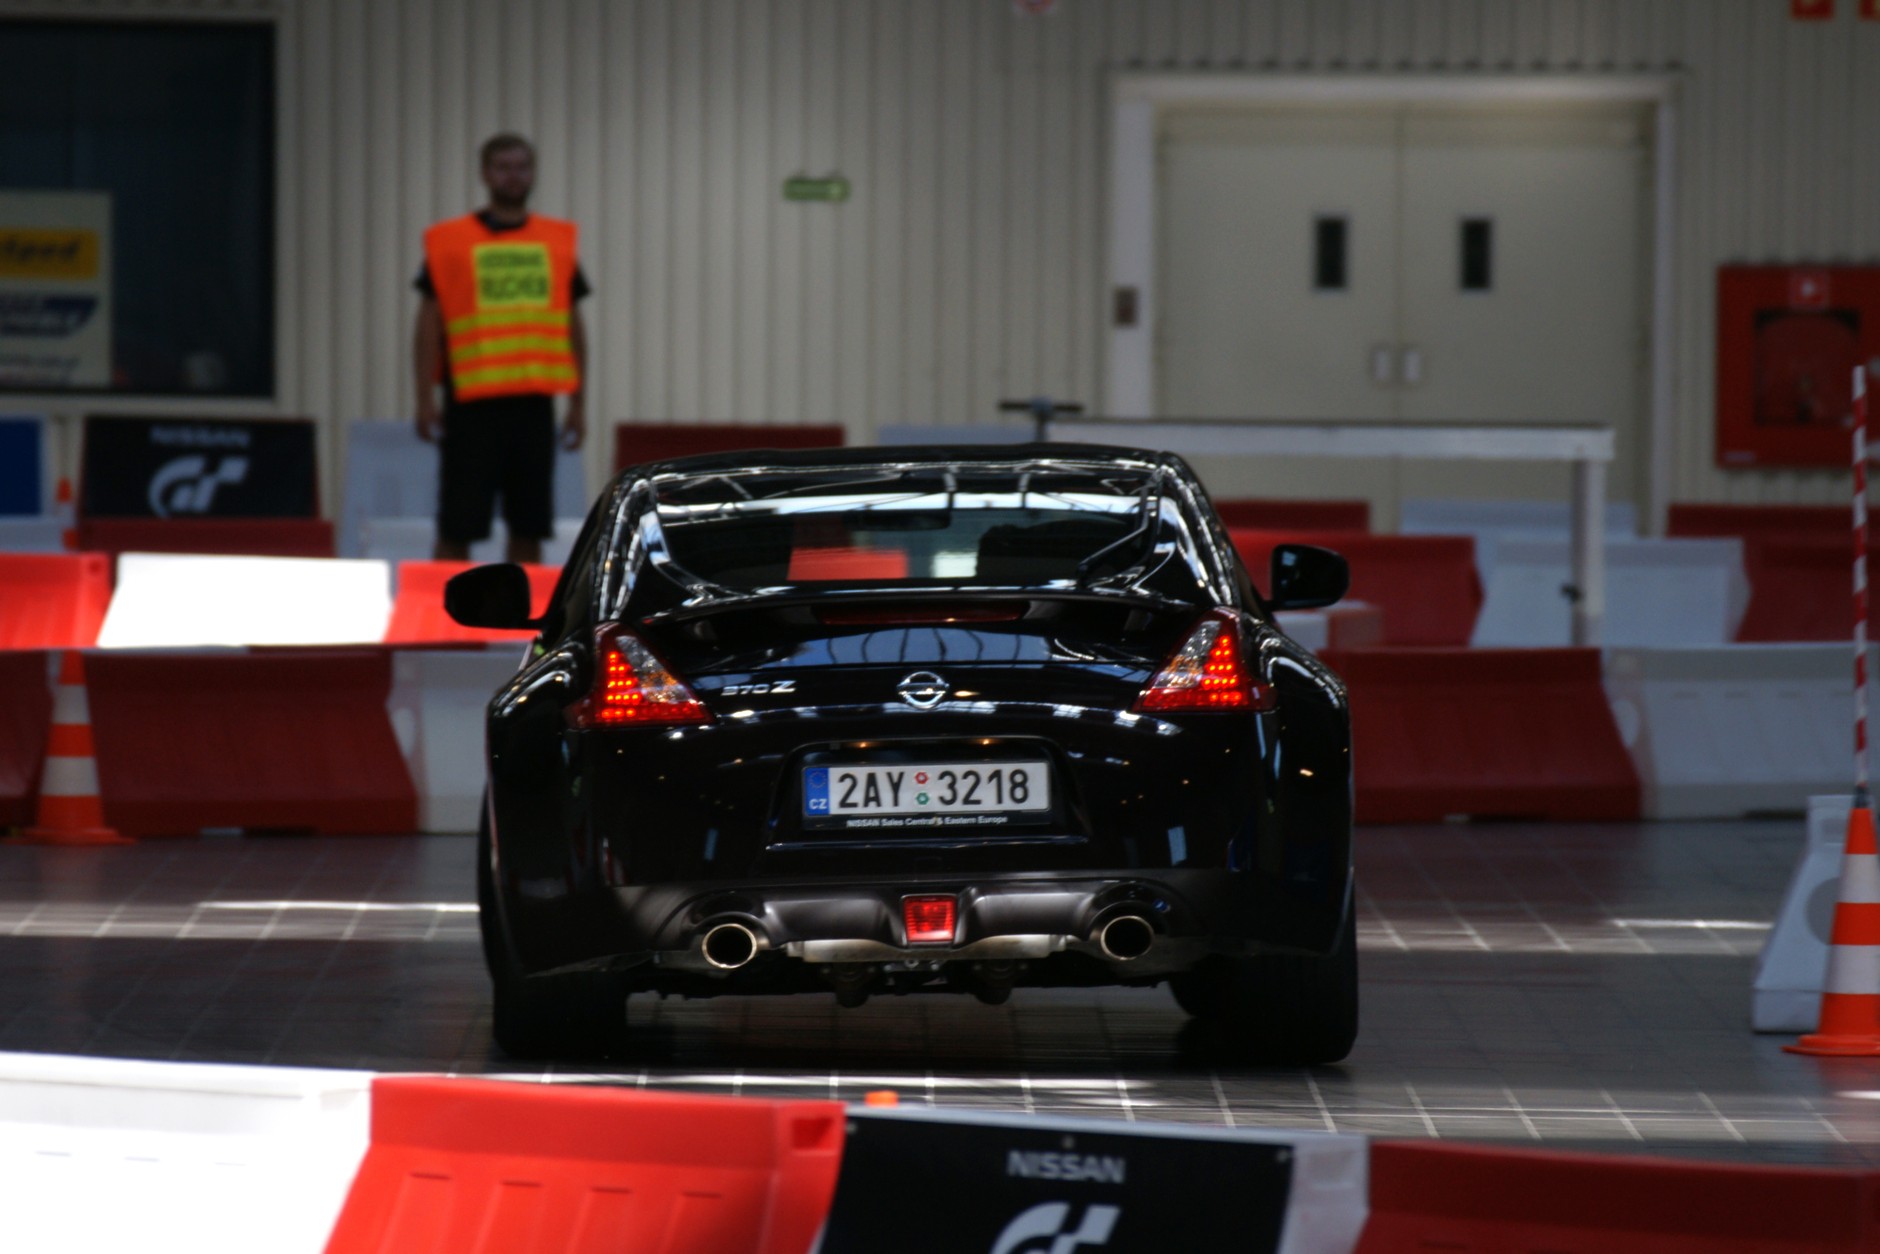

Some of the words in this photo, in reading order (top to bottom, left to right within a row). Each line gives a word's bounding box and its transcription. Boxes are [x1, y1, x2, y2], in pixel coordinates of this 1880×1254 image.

[838, 771, 905, 808] 2AY
[938, 769, 1029, 806] 3218
[809, 798, 827, 810] CZ
[880, 818, 904, 827] Sales
[944, 816, 977, 825] Eastern
[977, 815, 1008, 825] Europe
[1007, 1150, 1126, 1184] NISSAN
